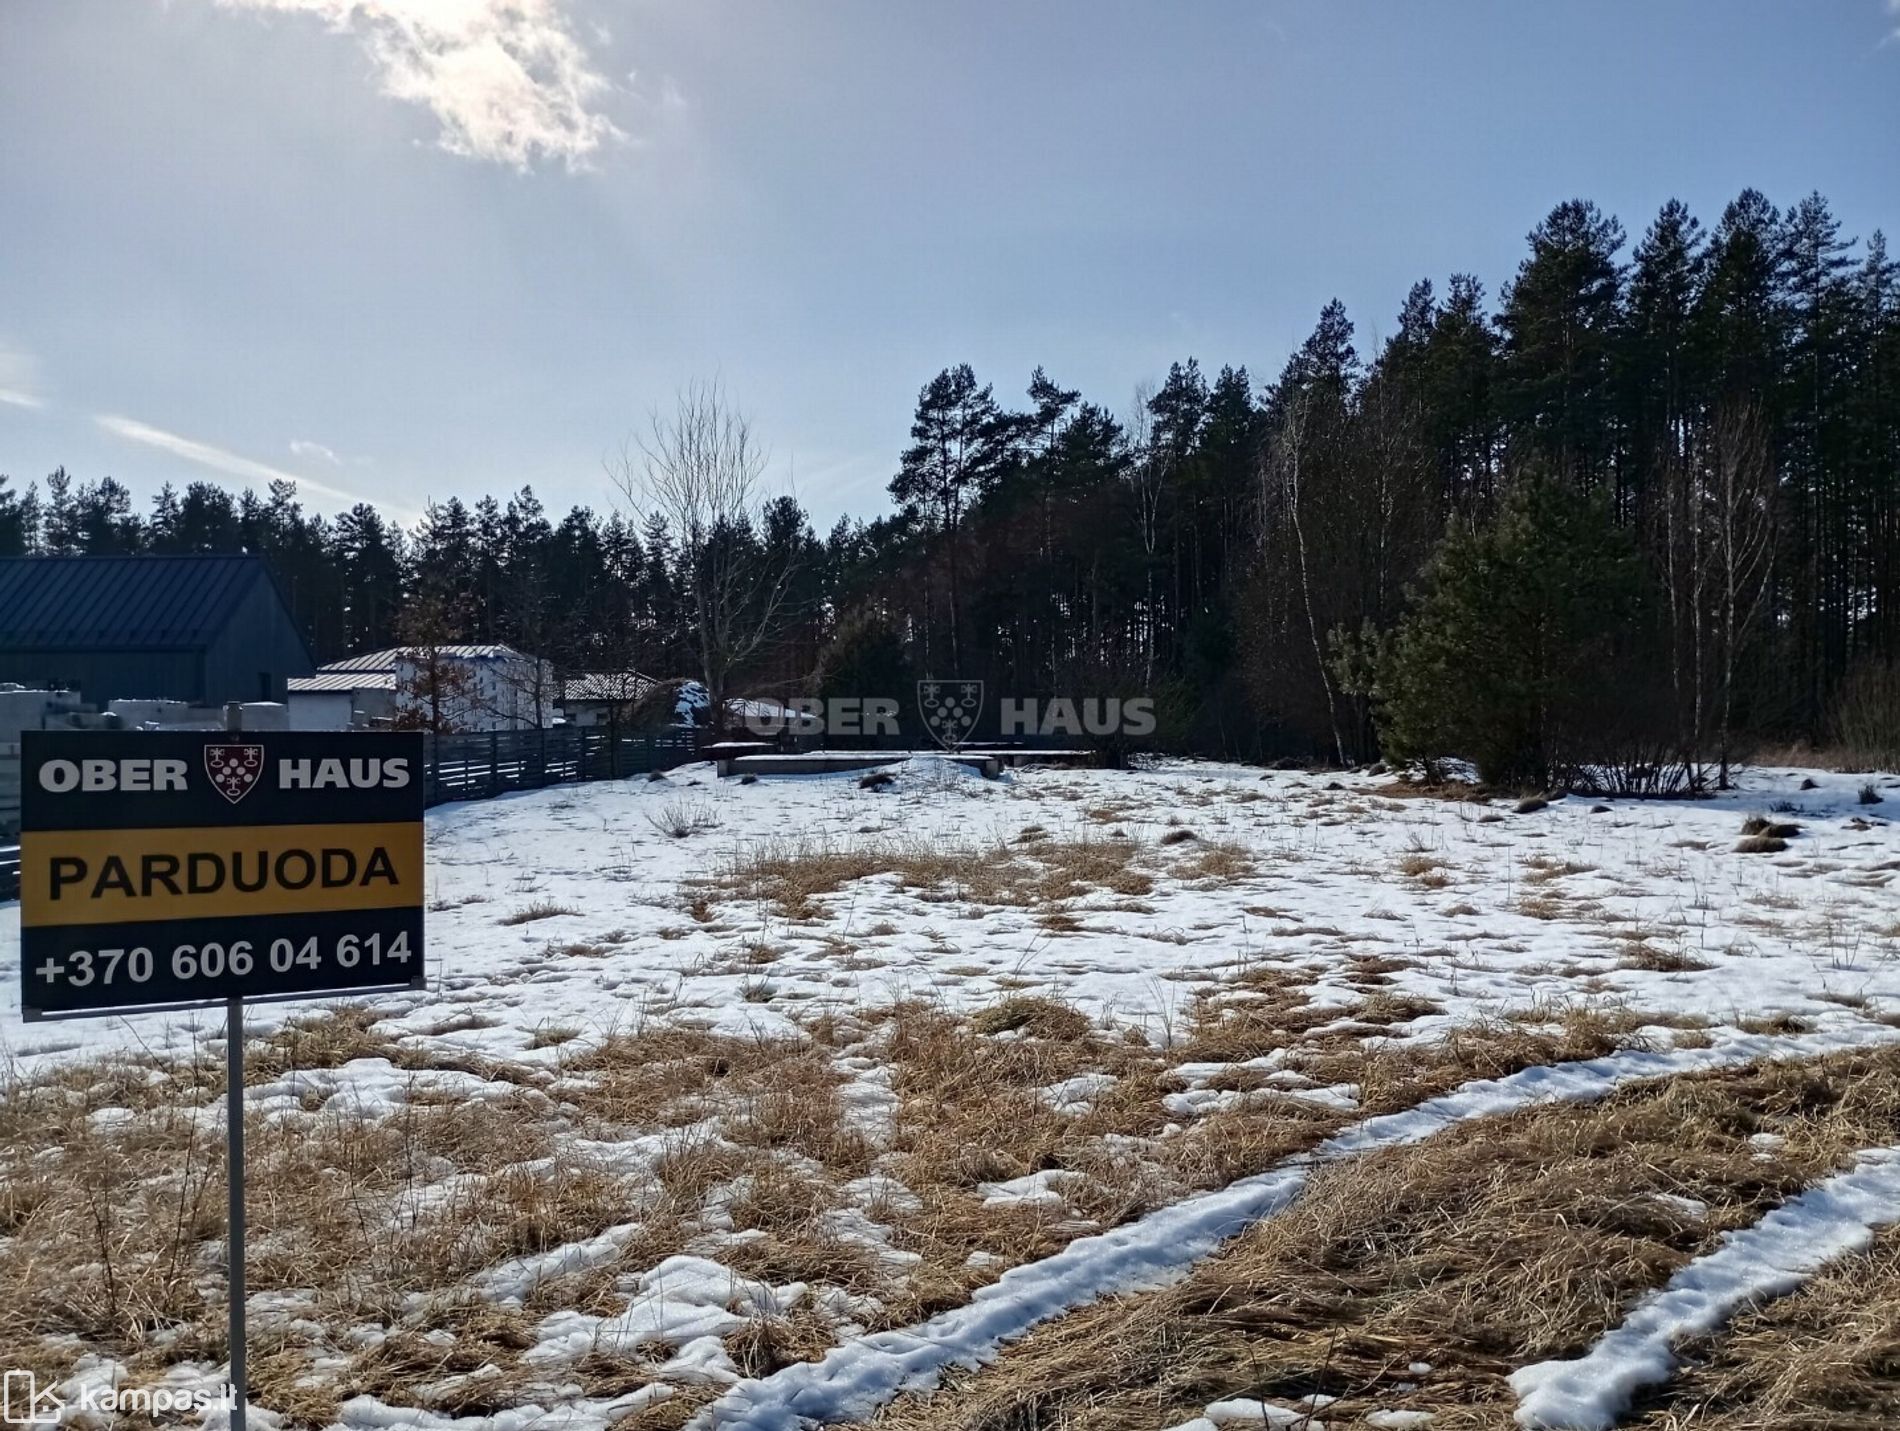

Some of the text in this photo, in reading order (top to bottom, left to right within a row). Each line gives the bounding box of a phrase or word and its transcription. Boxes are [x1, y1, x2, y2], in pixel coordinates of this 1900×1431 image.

[38, 758, 410, 792] OBER HAUS
[50, 847, 399, 901] PARDUODA
[36, 931, 412, 987] +370 606 04 614
